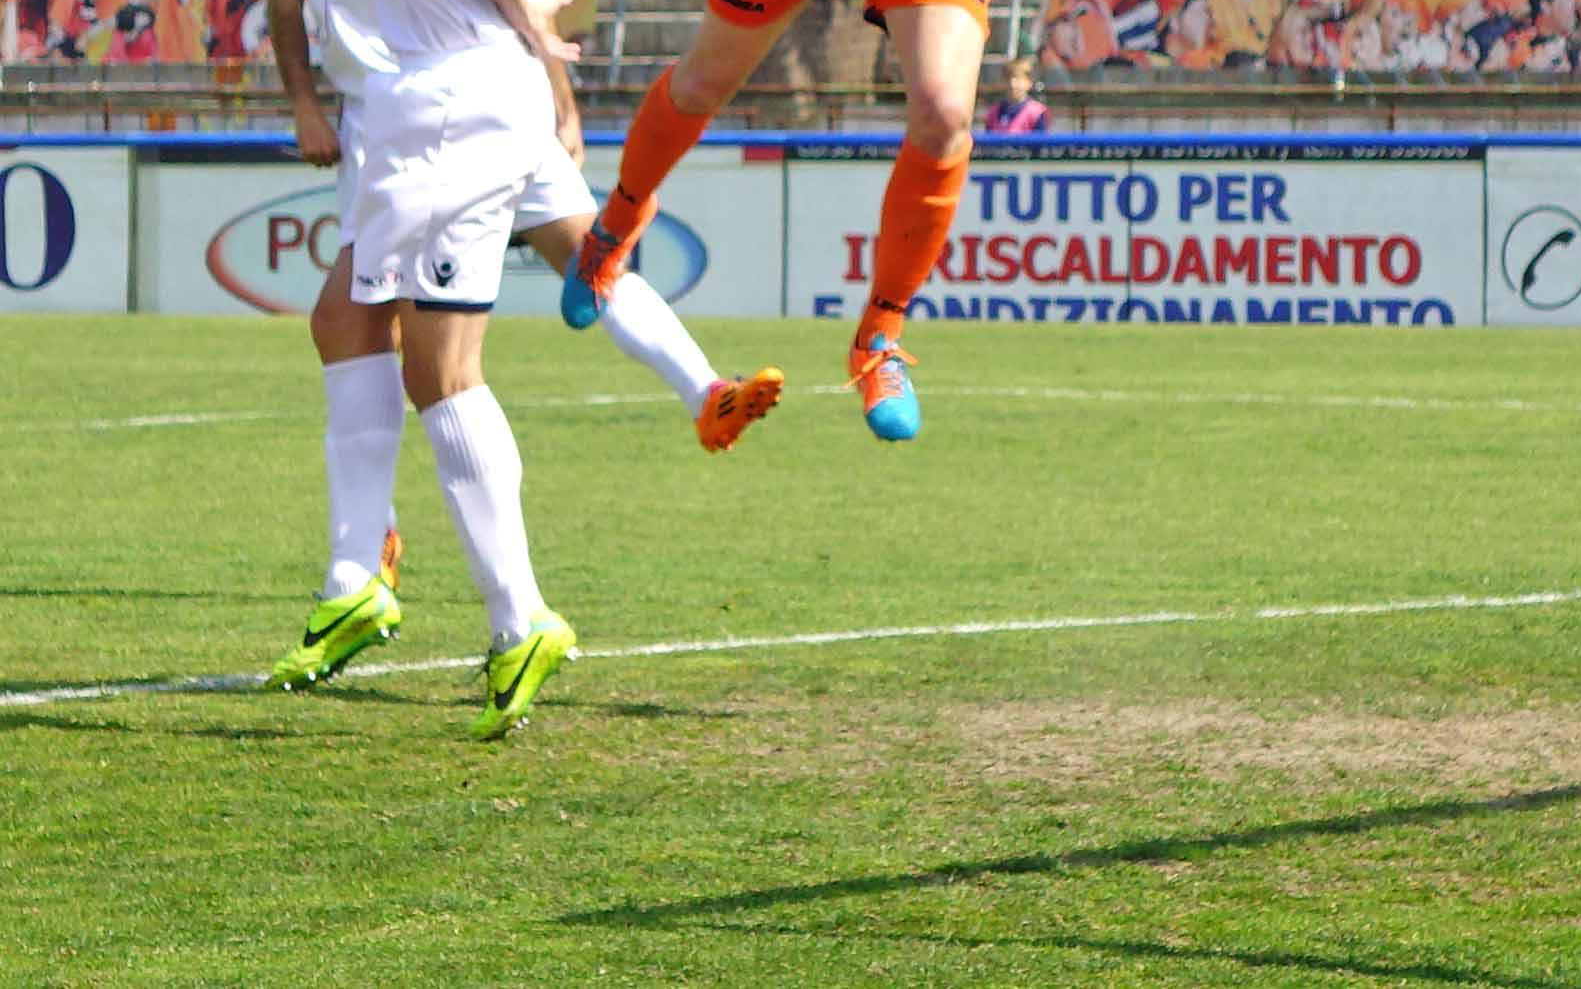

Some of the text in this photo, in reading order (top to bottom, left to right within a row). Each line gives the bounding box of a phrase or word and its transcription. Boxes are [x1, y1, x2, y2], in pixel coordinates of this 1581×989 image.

[970, 174, 1290, 222] TUTTO PER
[907, 296, 1455, 325] ONDIZIONAMENTO
